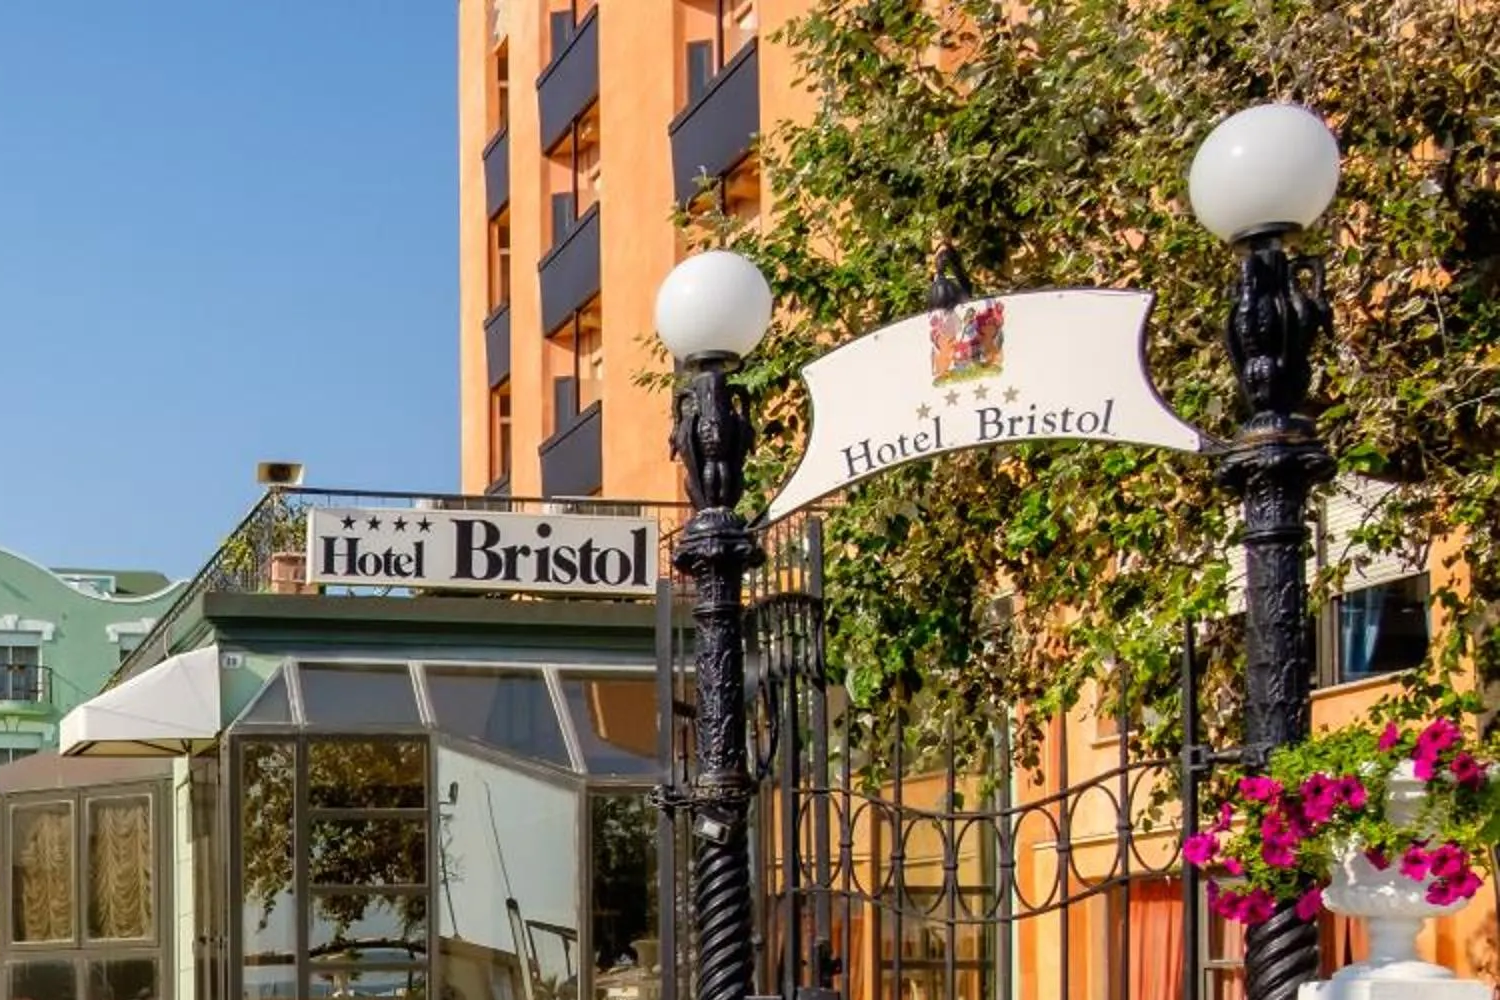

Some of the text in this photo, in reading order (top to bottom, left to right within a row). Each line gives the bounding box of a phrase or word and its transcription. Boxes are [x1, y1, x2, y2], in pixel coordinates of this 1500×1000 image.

[841, 399, 1115, 478] Hotel Bristol
[320, 518, 649, 587] Hotel Bristol
